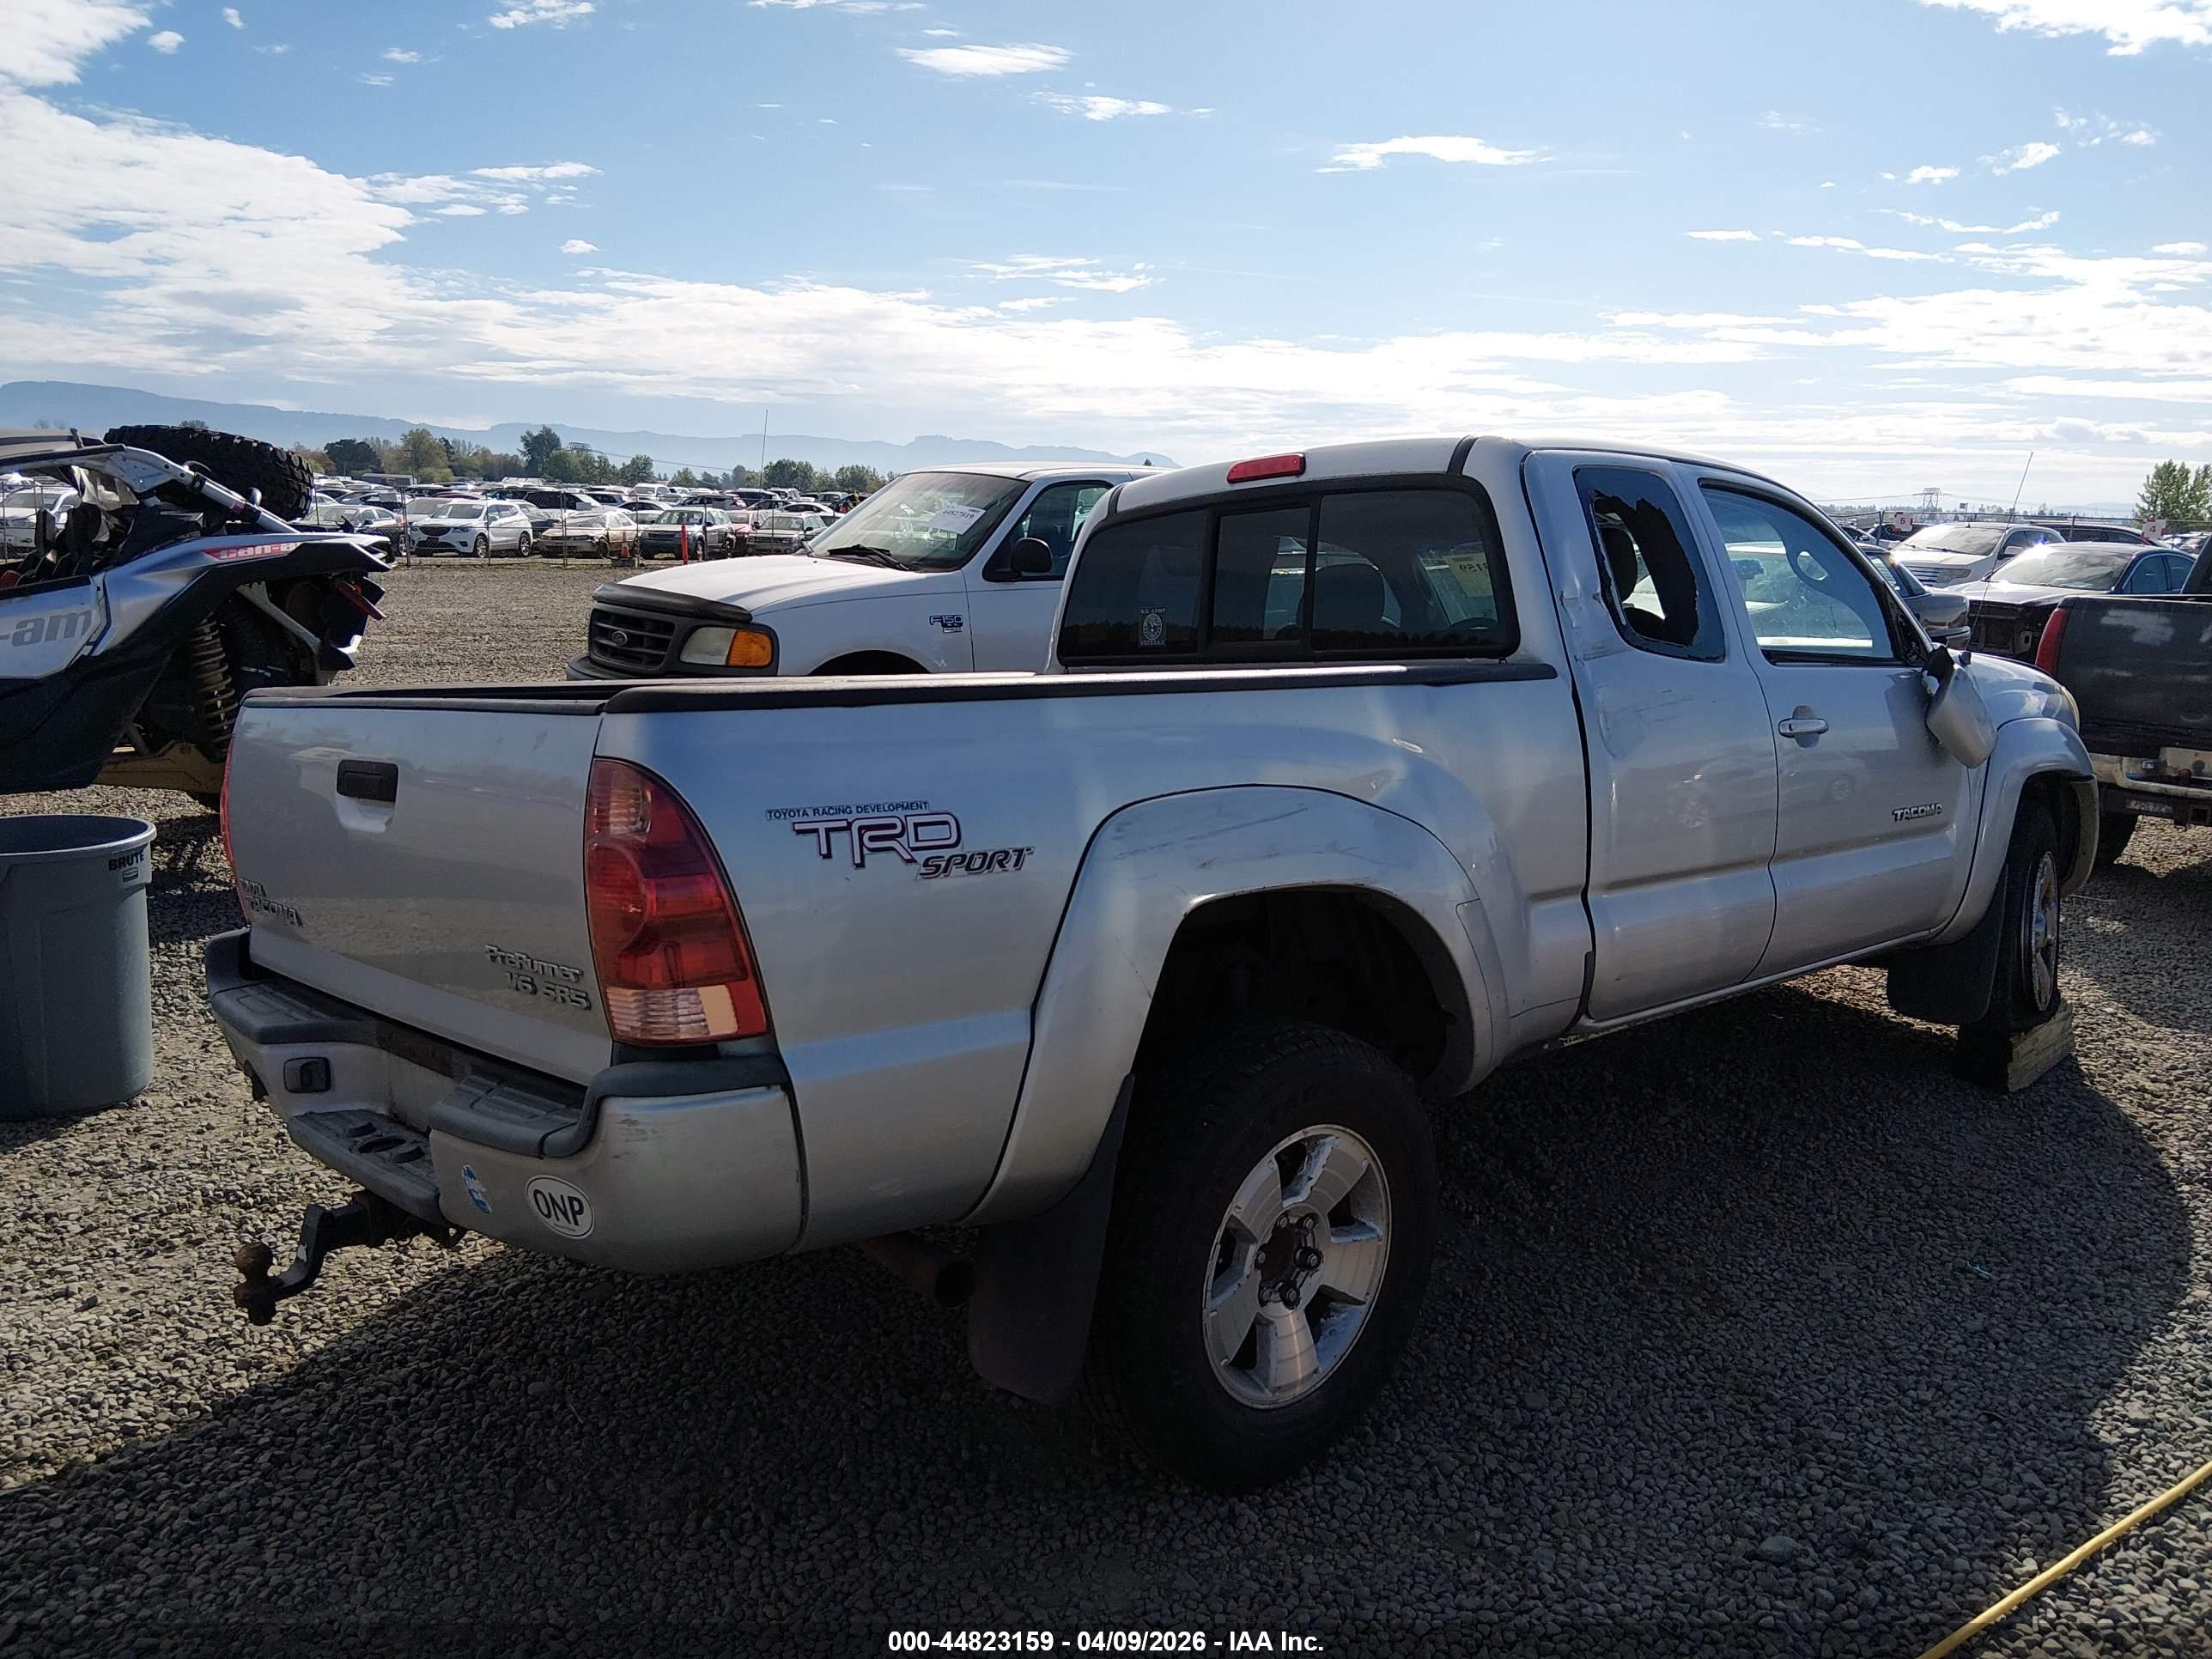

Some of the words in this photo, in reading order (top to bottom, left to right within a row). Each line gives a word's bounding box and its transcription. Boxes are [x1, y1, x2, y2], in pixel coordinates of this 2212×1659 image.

[768, 809, 810, 820] TOYOTA
[812, 805, 853, 817] RACING
[856, 801, 929, 814] DEVELOPMENT
[1892, 803, 1942, 822] TACOMA
[792, 811, 962, 870] TRD
[109, 853, 144, 871] BRUTE
[918, 847, 1036, 879] SPORT
[485, 944, 584, 983] PreRunner
[543, 981, 592, 1011] SR5
[533, 1188, 585, 1226] ONP
